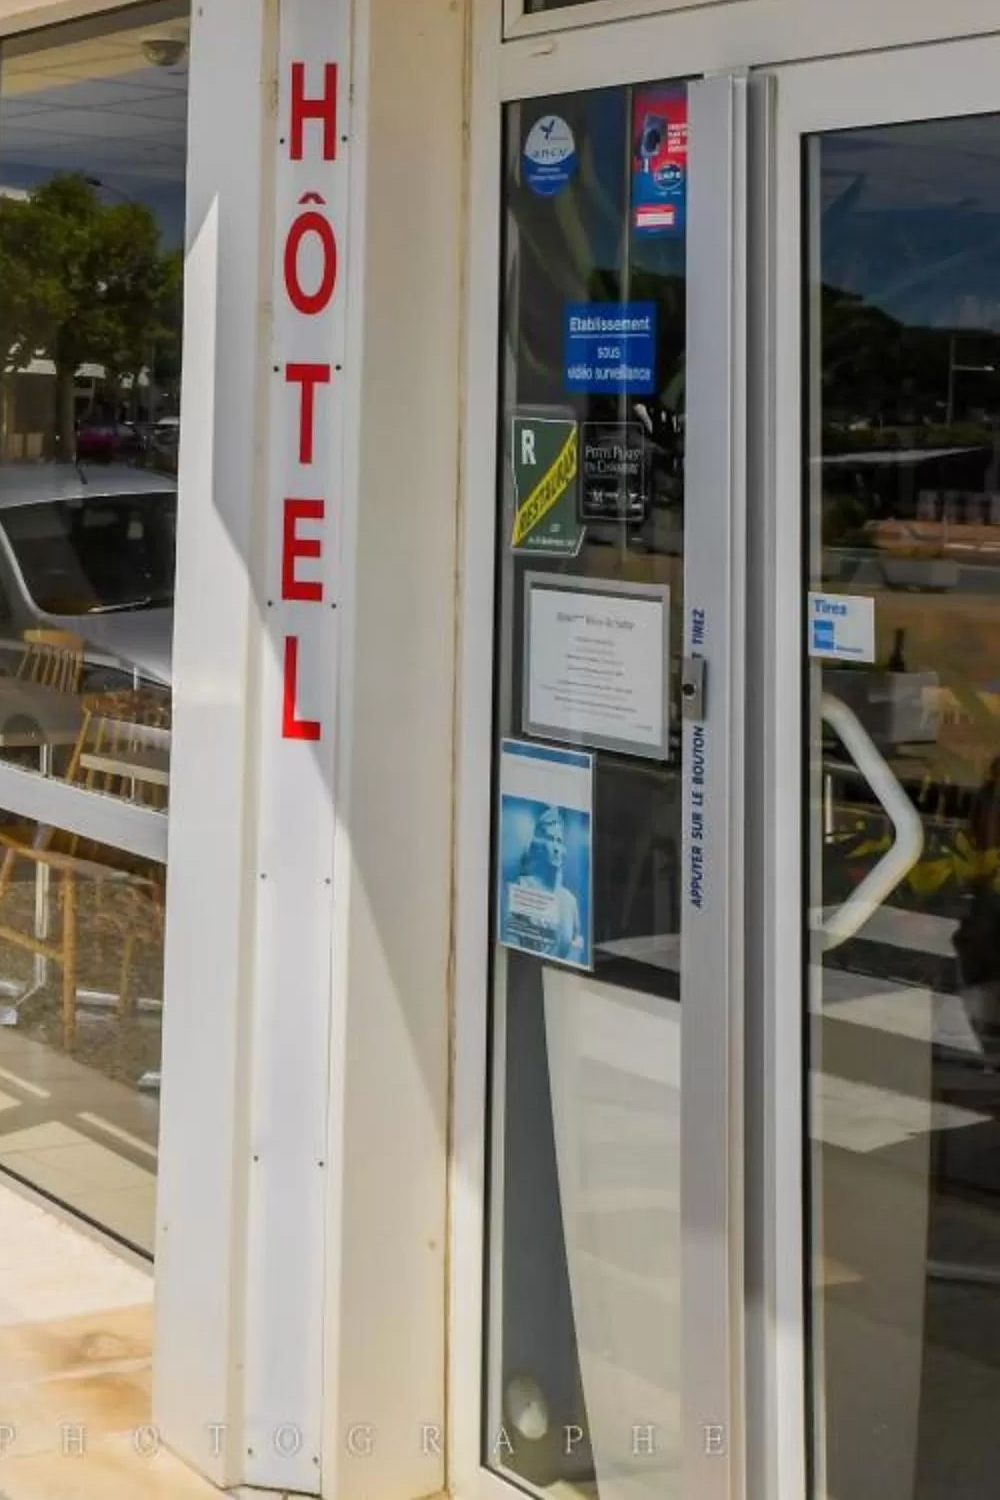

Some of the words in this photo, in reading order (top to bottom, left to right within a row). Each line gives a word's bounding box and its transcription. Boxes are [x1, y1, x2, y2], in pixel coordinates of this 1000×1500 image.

[569, 315, 650, 332] Etablissement
[281, 62, 338, 741] HÔTEL
[521, 428, 537, 465] R
[692, 608, 706, 645] TIREZ
[691, 726, 705, 785] BOUTON
[692, 790, 704, 809] LE
[692, 812, 704, 840] SUR
[691, 847, 705, 910] APPUYER
